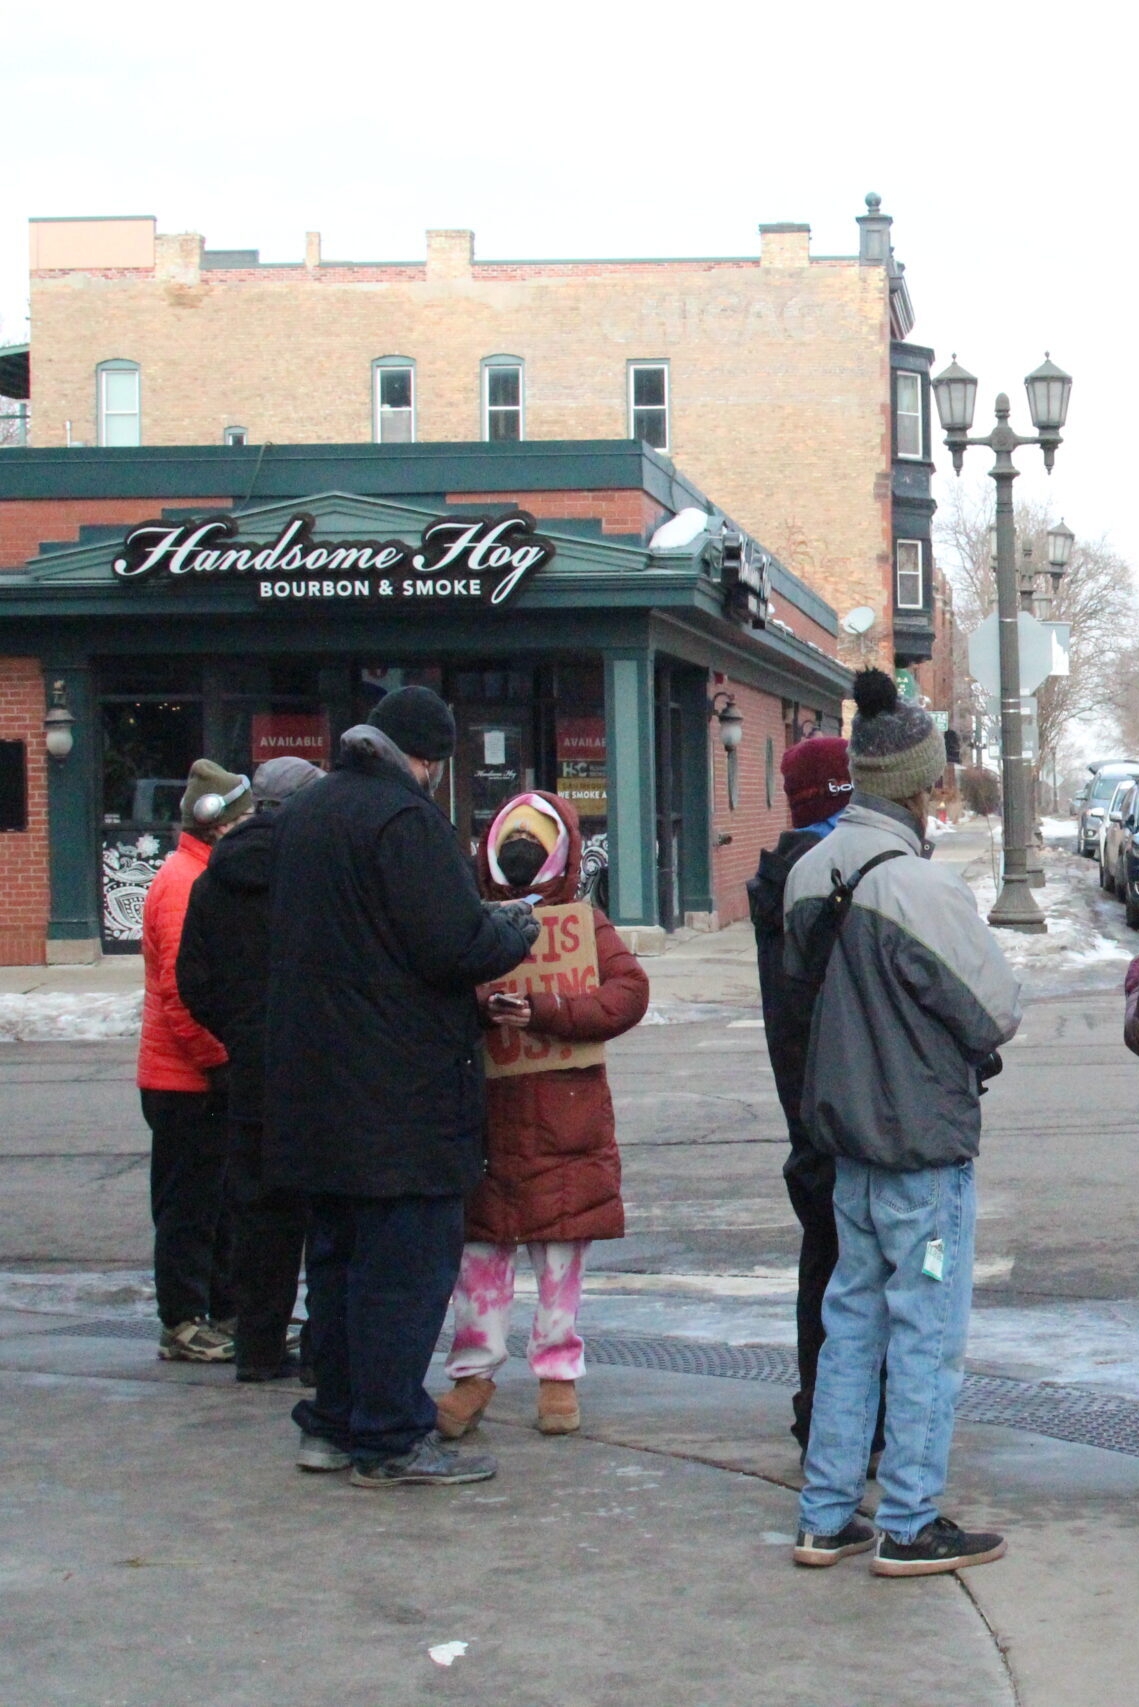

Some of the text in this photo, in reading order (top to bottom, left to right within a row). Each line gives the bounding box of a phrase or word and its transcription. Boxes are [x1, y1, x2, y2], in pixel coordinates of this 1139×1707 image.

[114, 519, 545, 604] Handsome Hog
[259, 579, 482, 597] BOURBON & SMOKE
[260, 736, 324, 747] AVAILABLE
[571, 790, 600, 800] SMOKE
